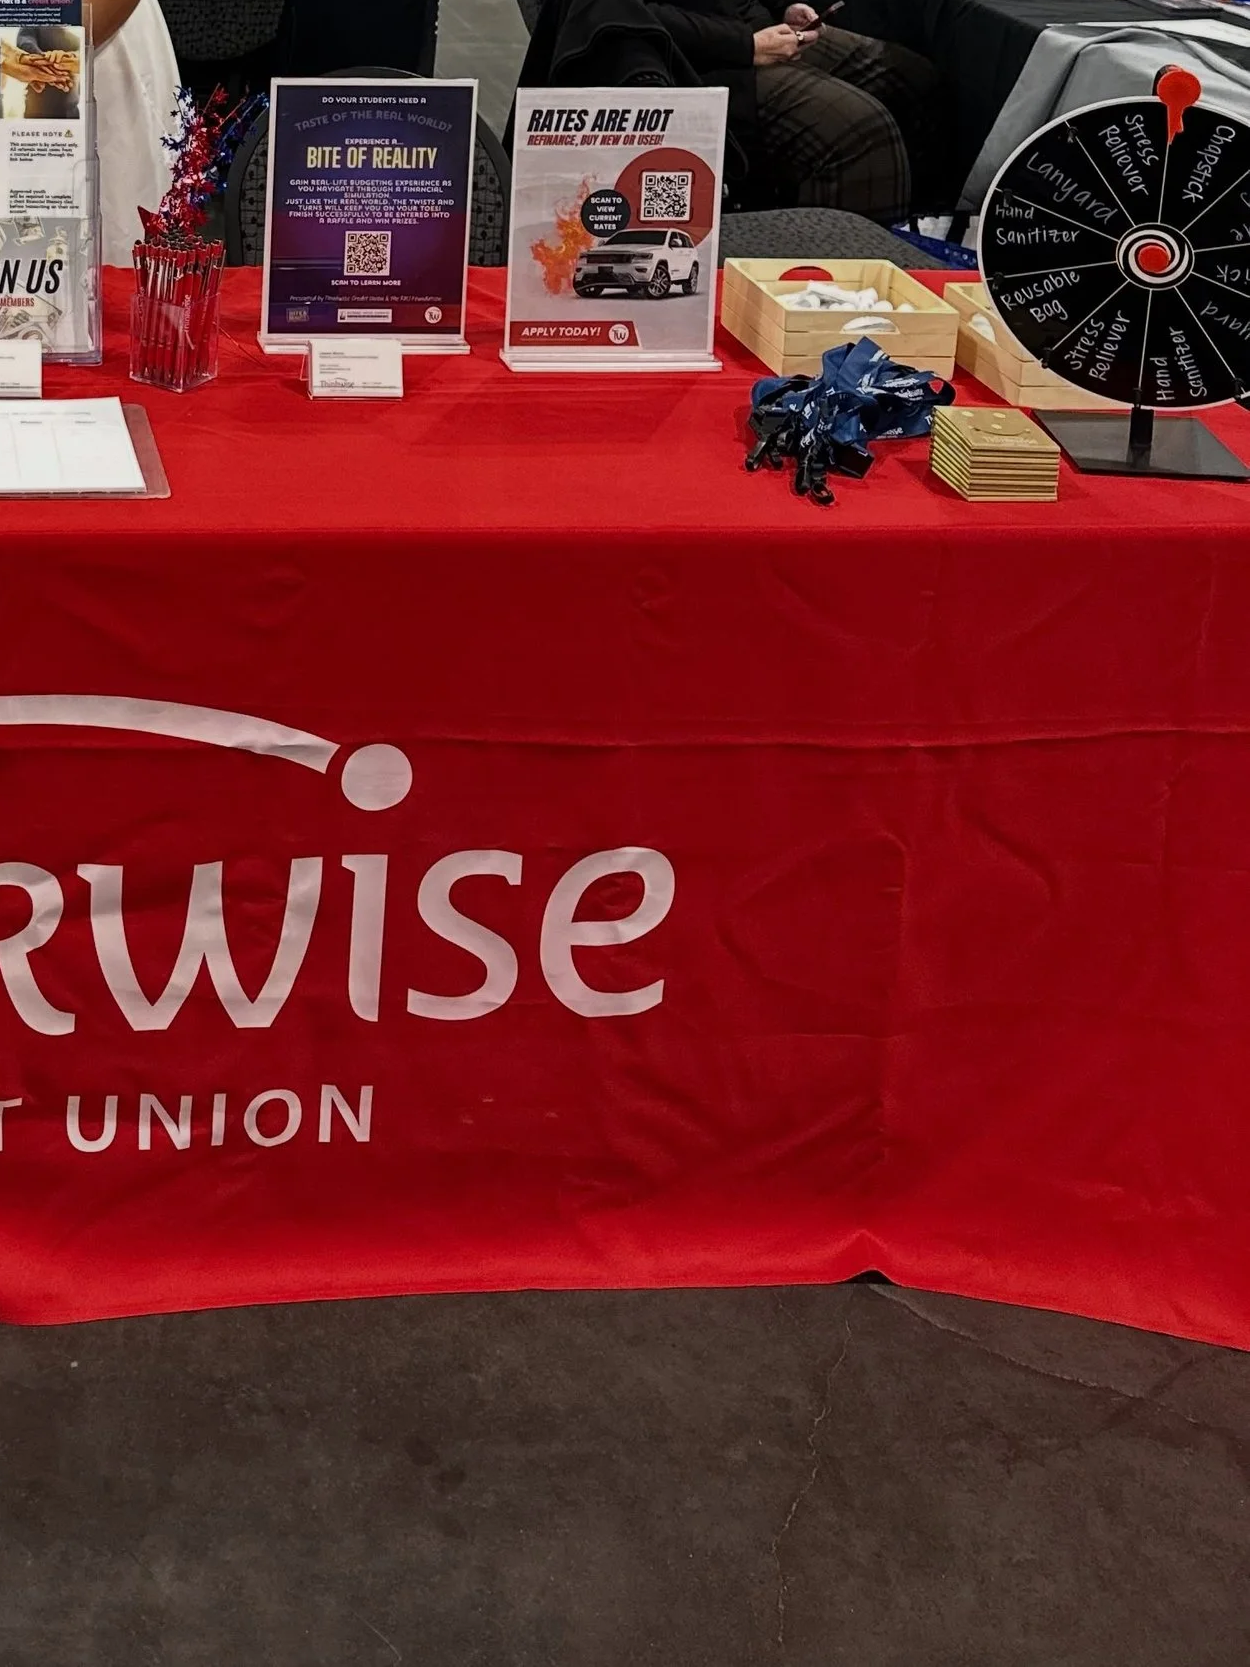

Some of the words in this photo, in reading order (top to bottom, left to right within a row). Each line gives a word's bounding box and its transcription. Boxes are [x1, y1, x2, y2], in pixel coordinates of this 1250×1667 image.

[295, 115, 329, 132] TASTE
[332, 112, 348, 122] OF
[350, 110, 372, 120] THE
[376, 111, 404, 121] REAL
[407, 113, 452, 132] WORLD?
[527, 109, 589, 132] RATES
[590, 109, 631, 131] ARE
[633, 109, 674, 132] HOT
[307, 147, 342, 169] BITE
[347, 147, 367, 168] OF
[372, 147, 438, 169] REALITY
[527, 135, 579, 147] REFINANCE,
[580, 135, 599, 146] BUY
[600, 135, 622, 145] NEW
[623, 135, 635, 145] OR
[638, 134, 664, 146] USED!
[1124, 114, 1159, 166] Stress
[1098, 124, 1149, 196] Reliever
[1182, 125, 1236, 203] Chapstick
[1026, 151, 1119, 224] Lanyard
[995, 204, 1034, 220] Hand
[996, 225, 1080, 245] Sanitizer
[26, 260, 63, 294] US
[1000, 269, 1081, 311] Reusable
[0, 298, 35, 306] MEMBERS
[1030, 300, 1068, 324] Bag
[521, 327, 556, 336] APPLY
[558, 327, 601, 336] TODAY!
[1064, 319, 1105, 371] Stress
[1089, 310, 1131, 381] Reliever
[1150, 357, 1176, 402] Hand
[1168, 326, 1208, 398] Sanitizer
[63, 1084, 376, 1154] UNION
